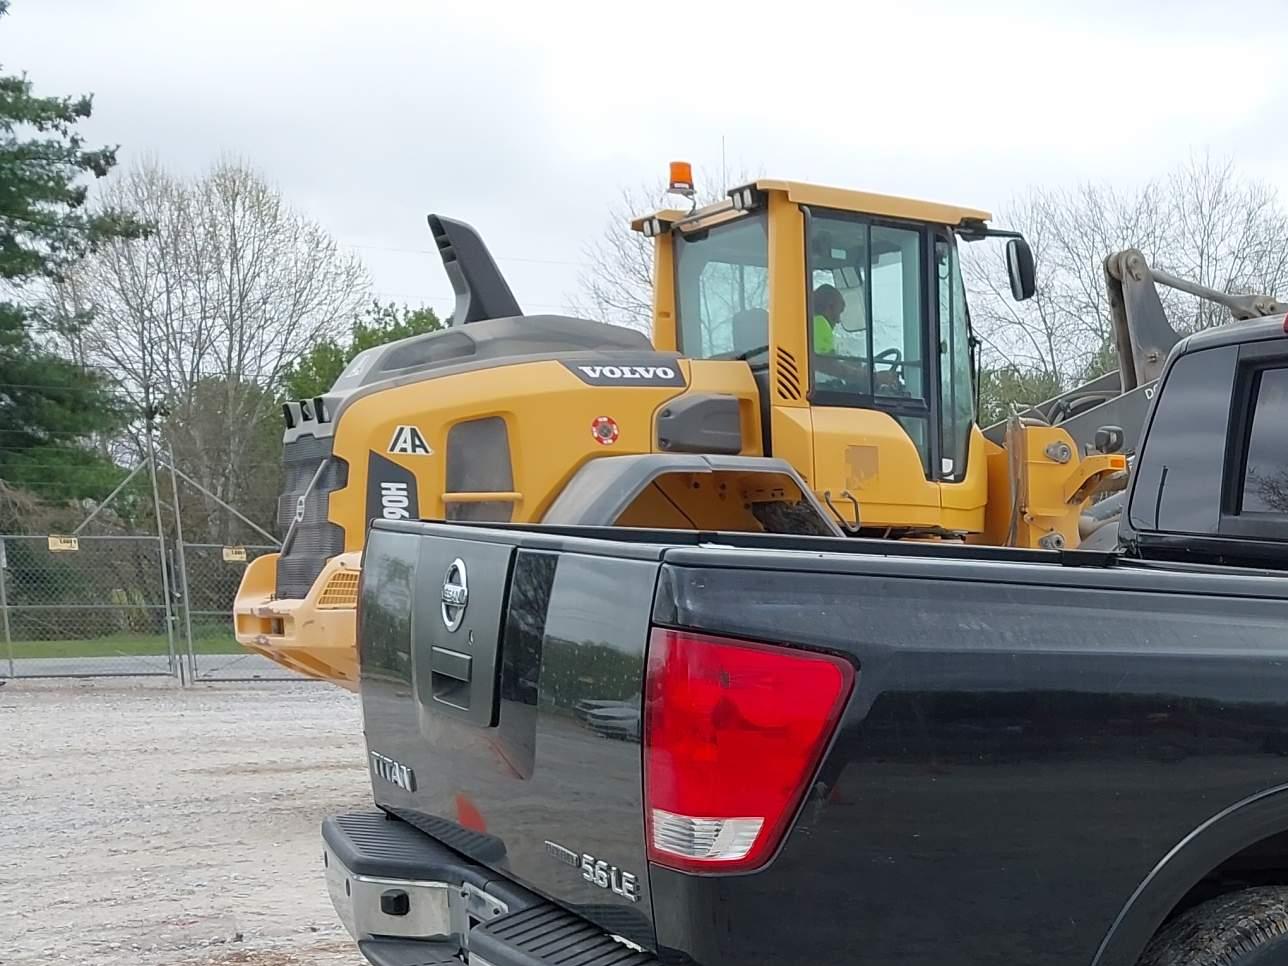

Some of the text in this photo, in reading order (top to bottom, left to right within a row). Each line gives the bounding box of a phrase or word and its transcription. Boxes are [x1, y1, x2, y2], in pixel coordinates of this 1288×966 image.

[578, 366, 675, 379] VOLVO
[371, 751, 416, 792] TITAN
[611, 867, 640, 902] LE
